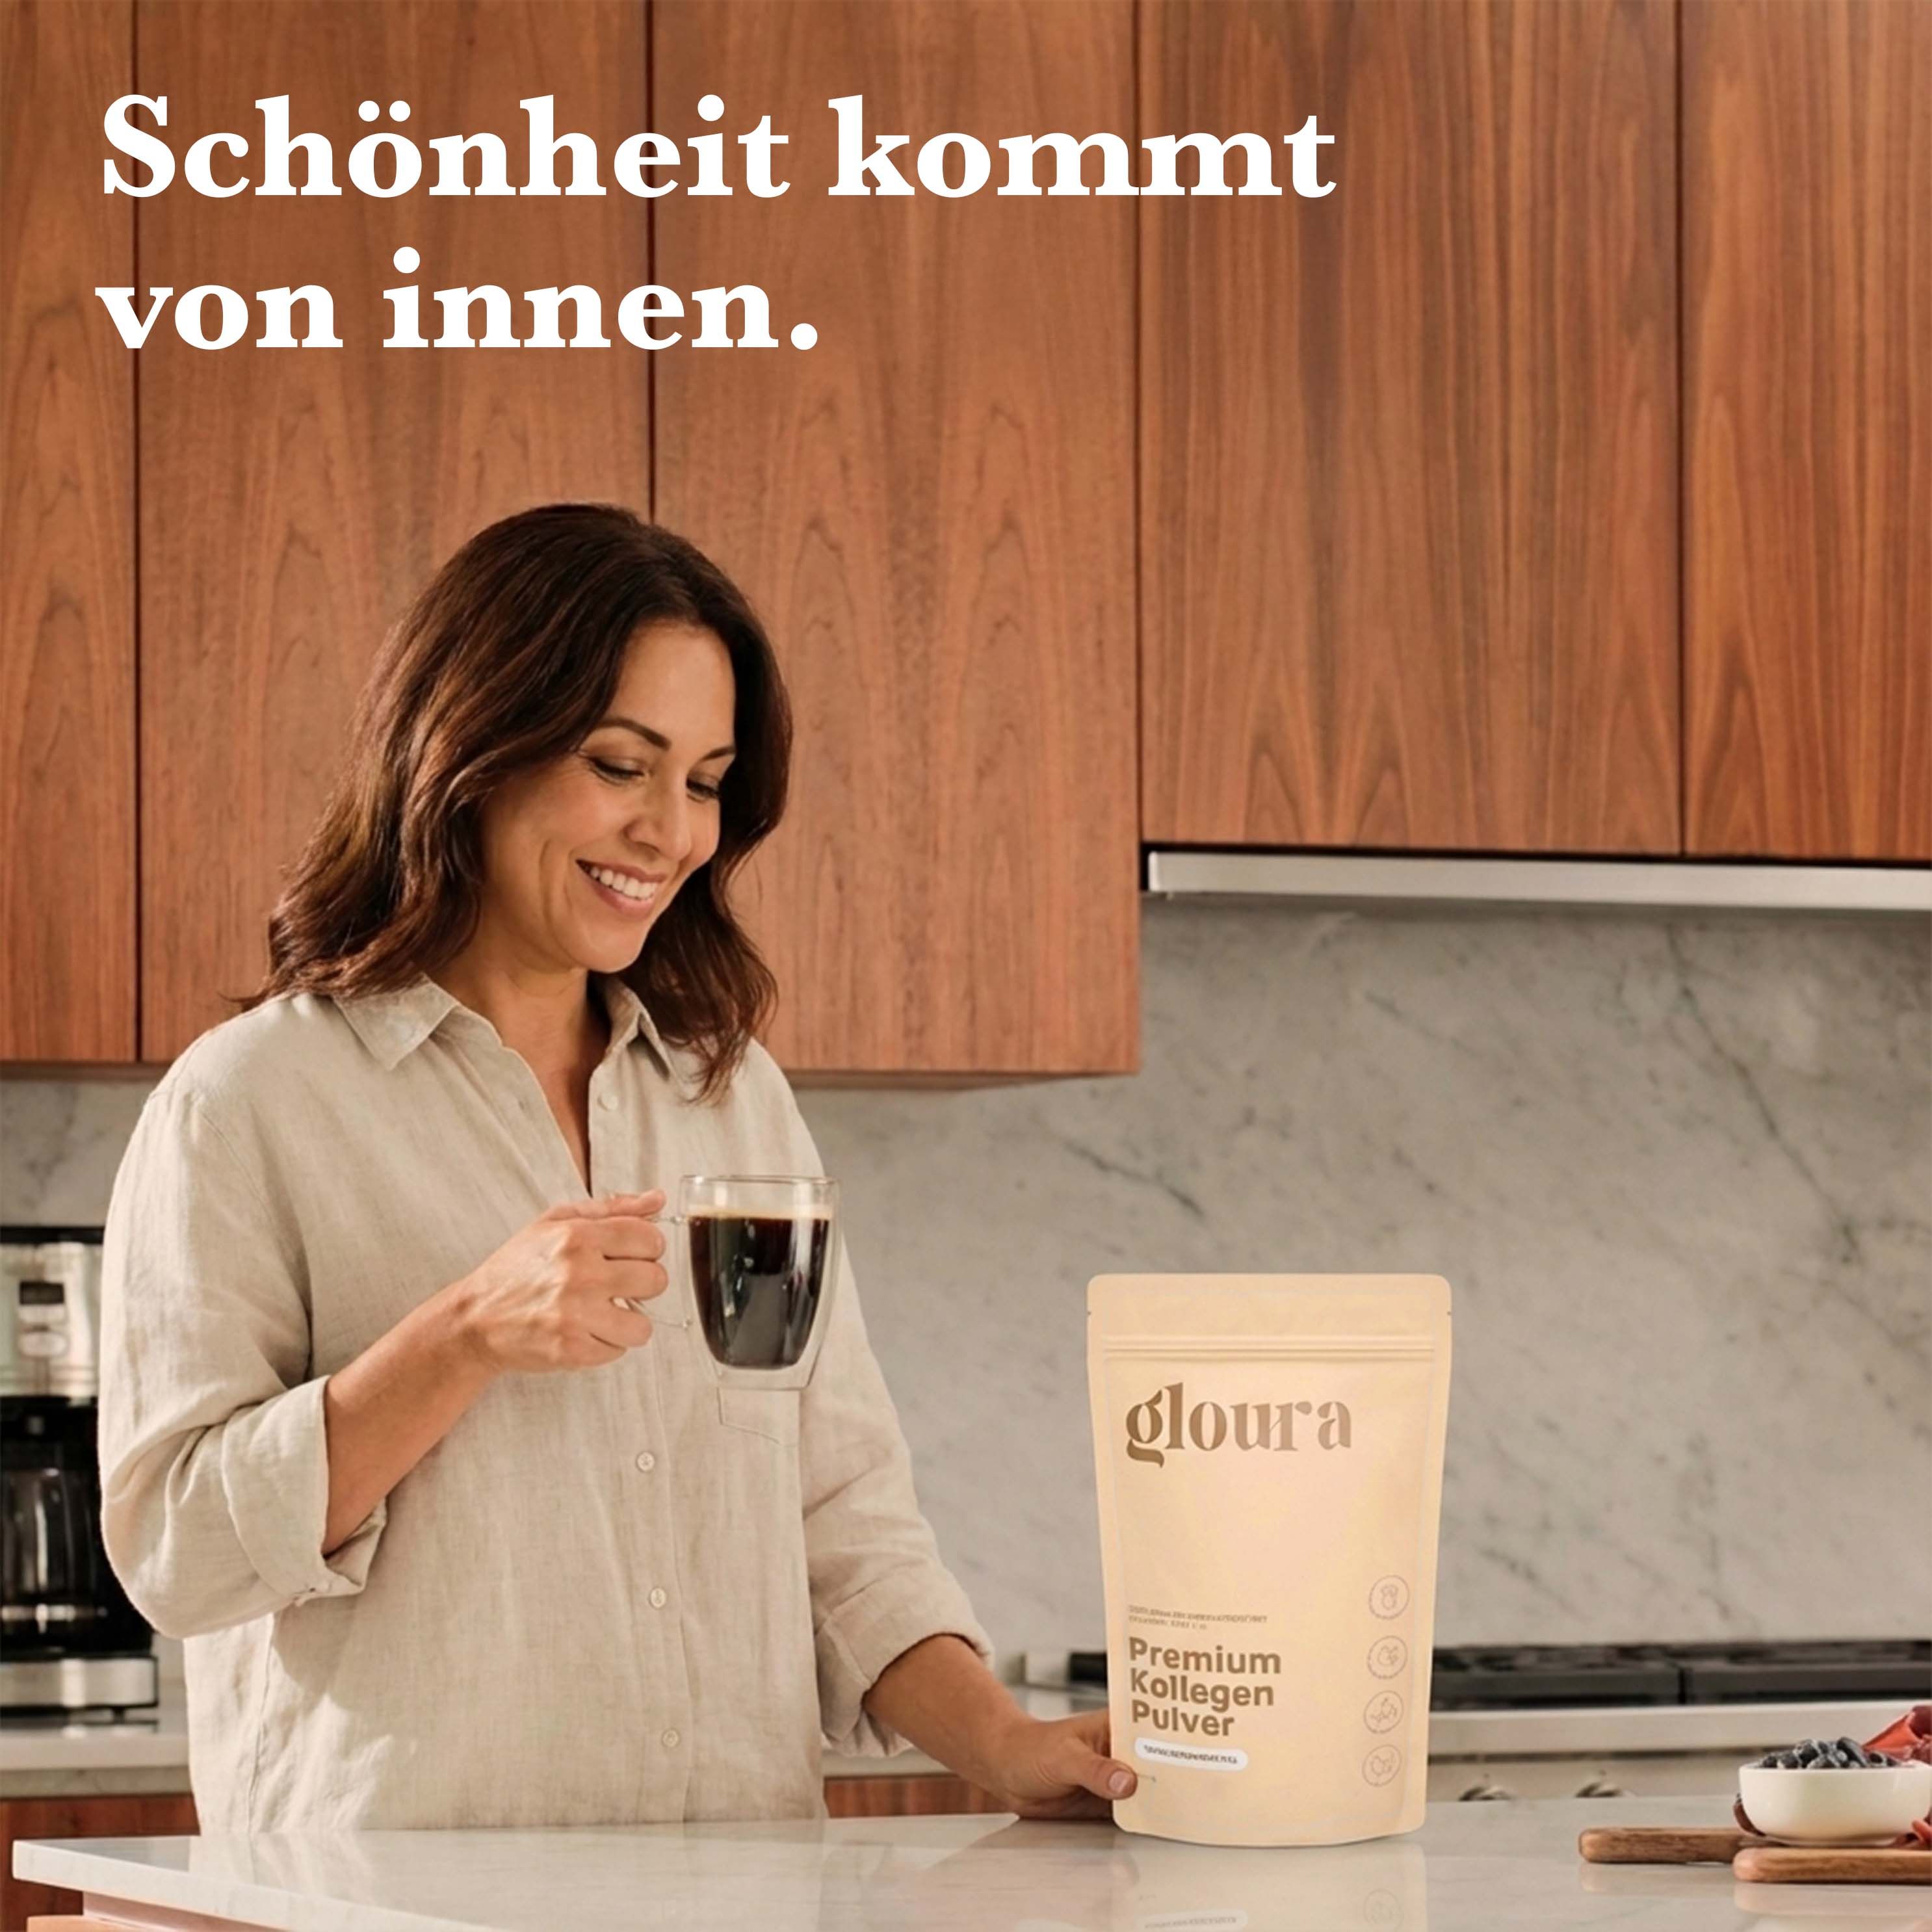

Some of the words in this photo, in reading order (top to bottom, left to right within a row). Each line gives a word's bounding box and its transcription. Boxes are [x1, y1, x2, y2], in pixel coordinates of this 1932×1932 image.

[1125, 1381, 1352, 1469] gloura
[1129, 1636, 1282, 1675] Premium
[1130, 1668, 1275, 1713] Kollegen
[1132, 1699, 1235, 1736] Pulver
